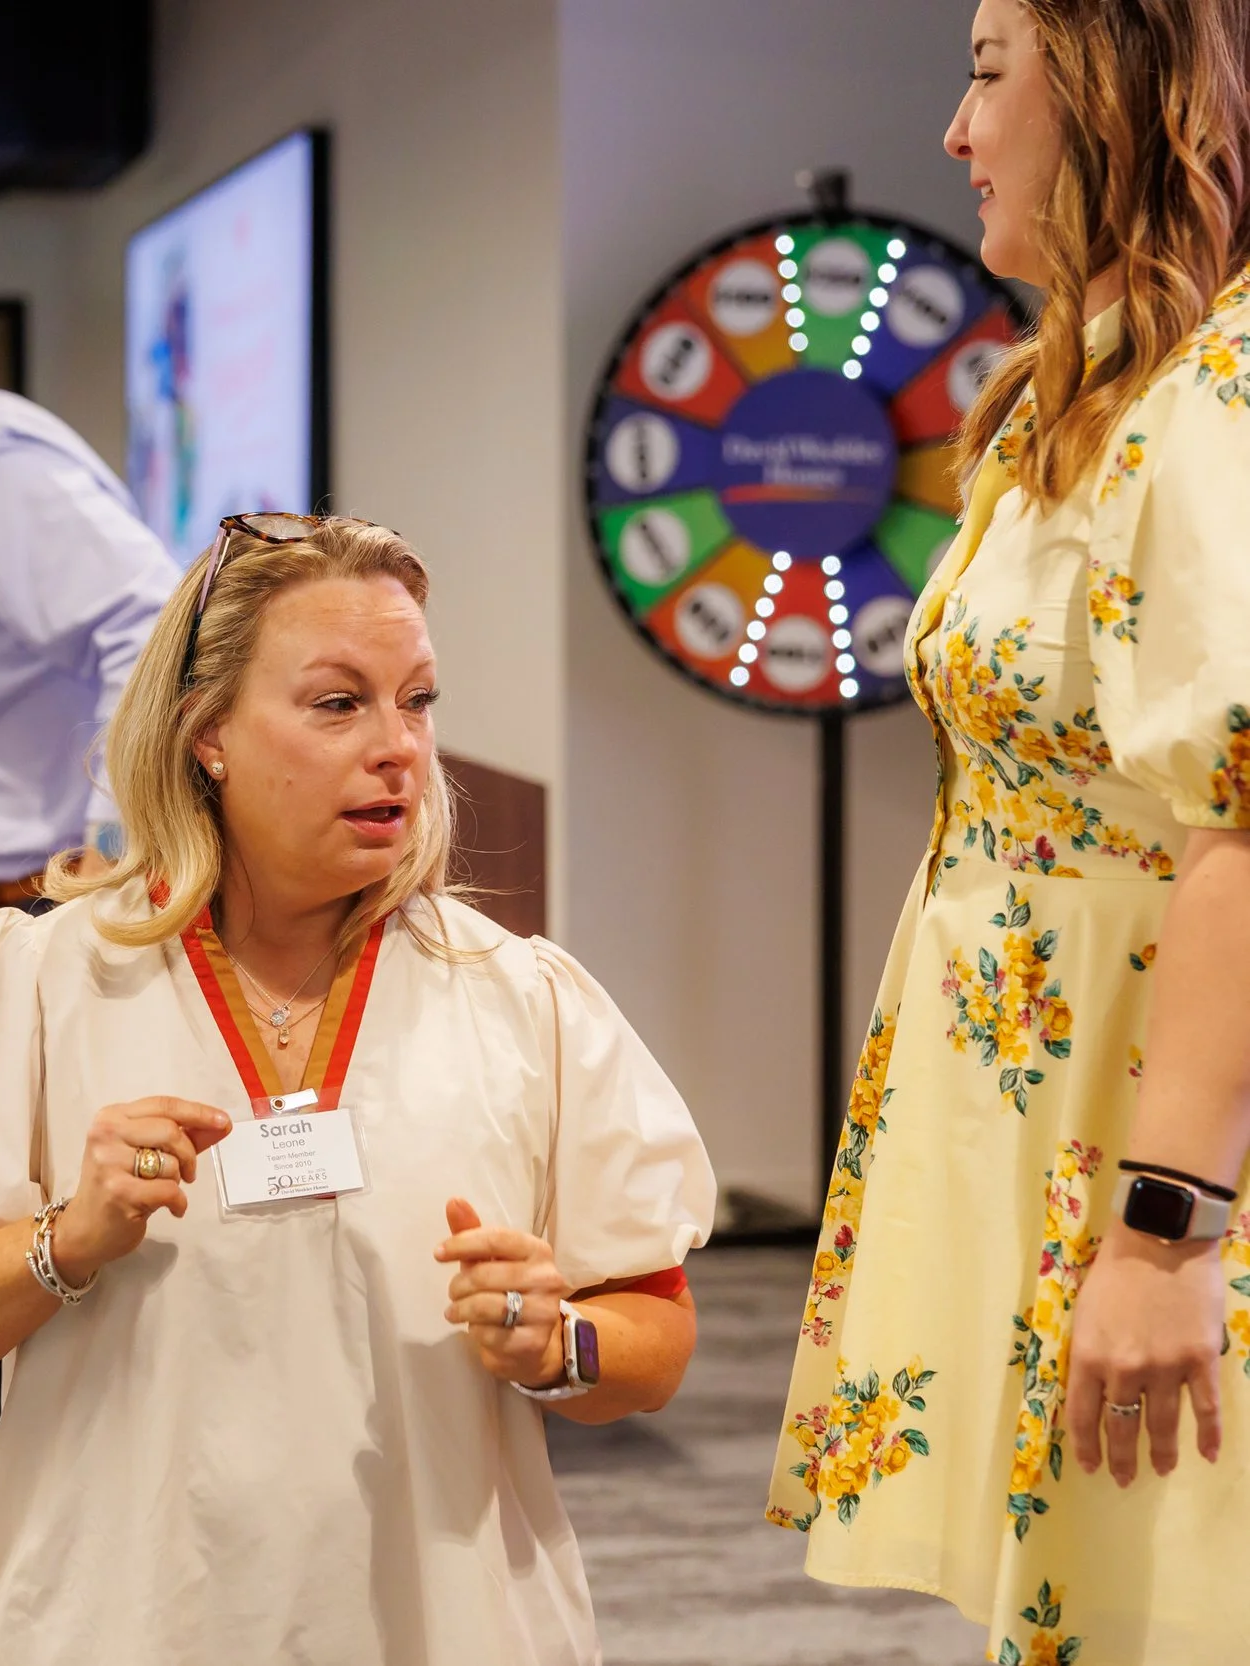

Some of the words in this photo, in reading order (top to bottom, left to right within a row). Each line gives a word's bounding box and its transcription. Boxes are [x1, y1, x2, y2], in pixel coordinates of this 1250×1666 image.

[260, 1120, 312, 1138] Sarah
[272, 1138, 306, 1150] Leone
[267, 1154, 286, 1162] Team
[288, 1150, 316, 1159] Member
[274, 1162, 293, 1171] Since
[295, 1160, 312, 1168] 2010
[267, 1174, 293, 1196] 50
[294, 1172, 328, 1183] YEARS
